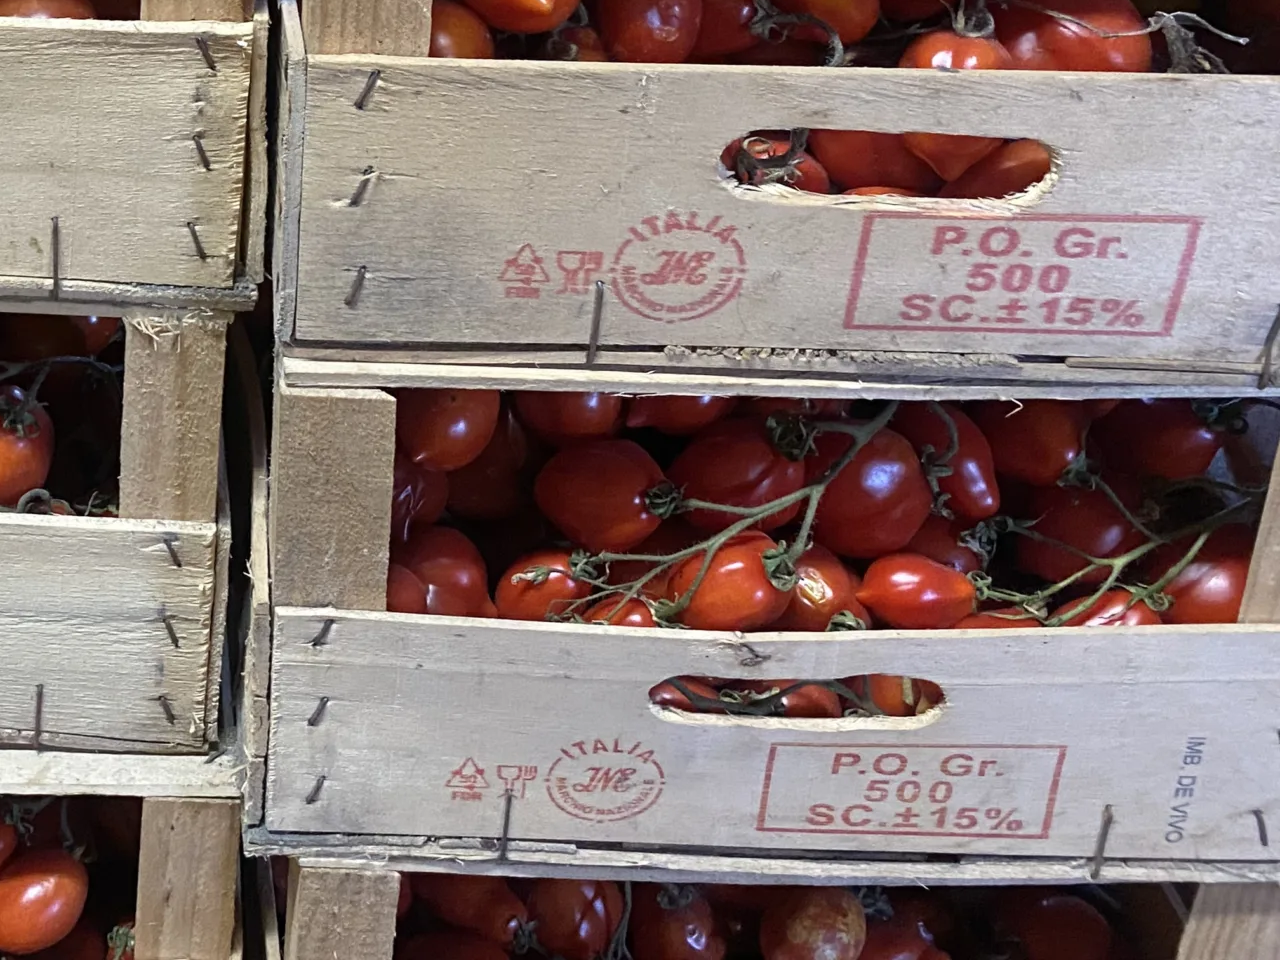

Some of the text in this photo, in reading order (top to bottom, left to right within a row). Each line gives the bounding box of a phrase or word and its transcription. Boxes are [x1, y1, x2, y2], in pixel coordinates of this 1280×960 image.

[628, 210, 739, 245] ITALIA
[931, 225, 1129, 259] P.O. Gr.
[965, 263, 1071, 294] 500
[560, 737, 655, 765] ITALIA
[831, 752, 1005, 778] P.O. Gr.
[863, 780, 954, 804] 500
[1174, 775, 1198, 799] DE
[1164, 802, 1191, 844] VIVO
